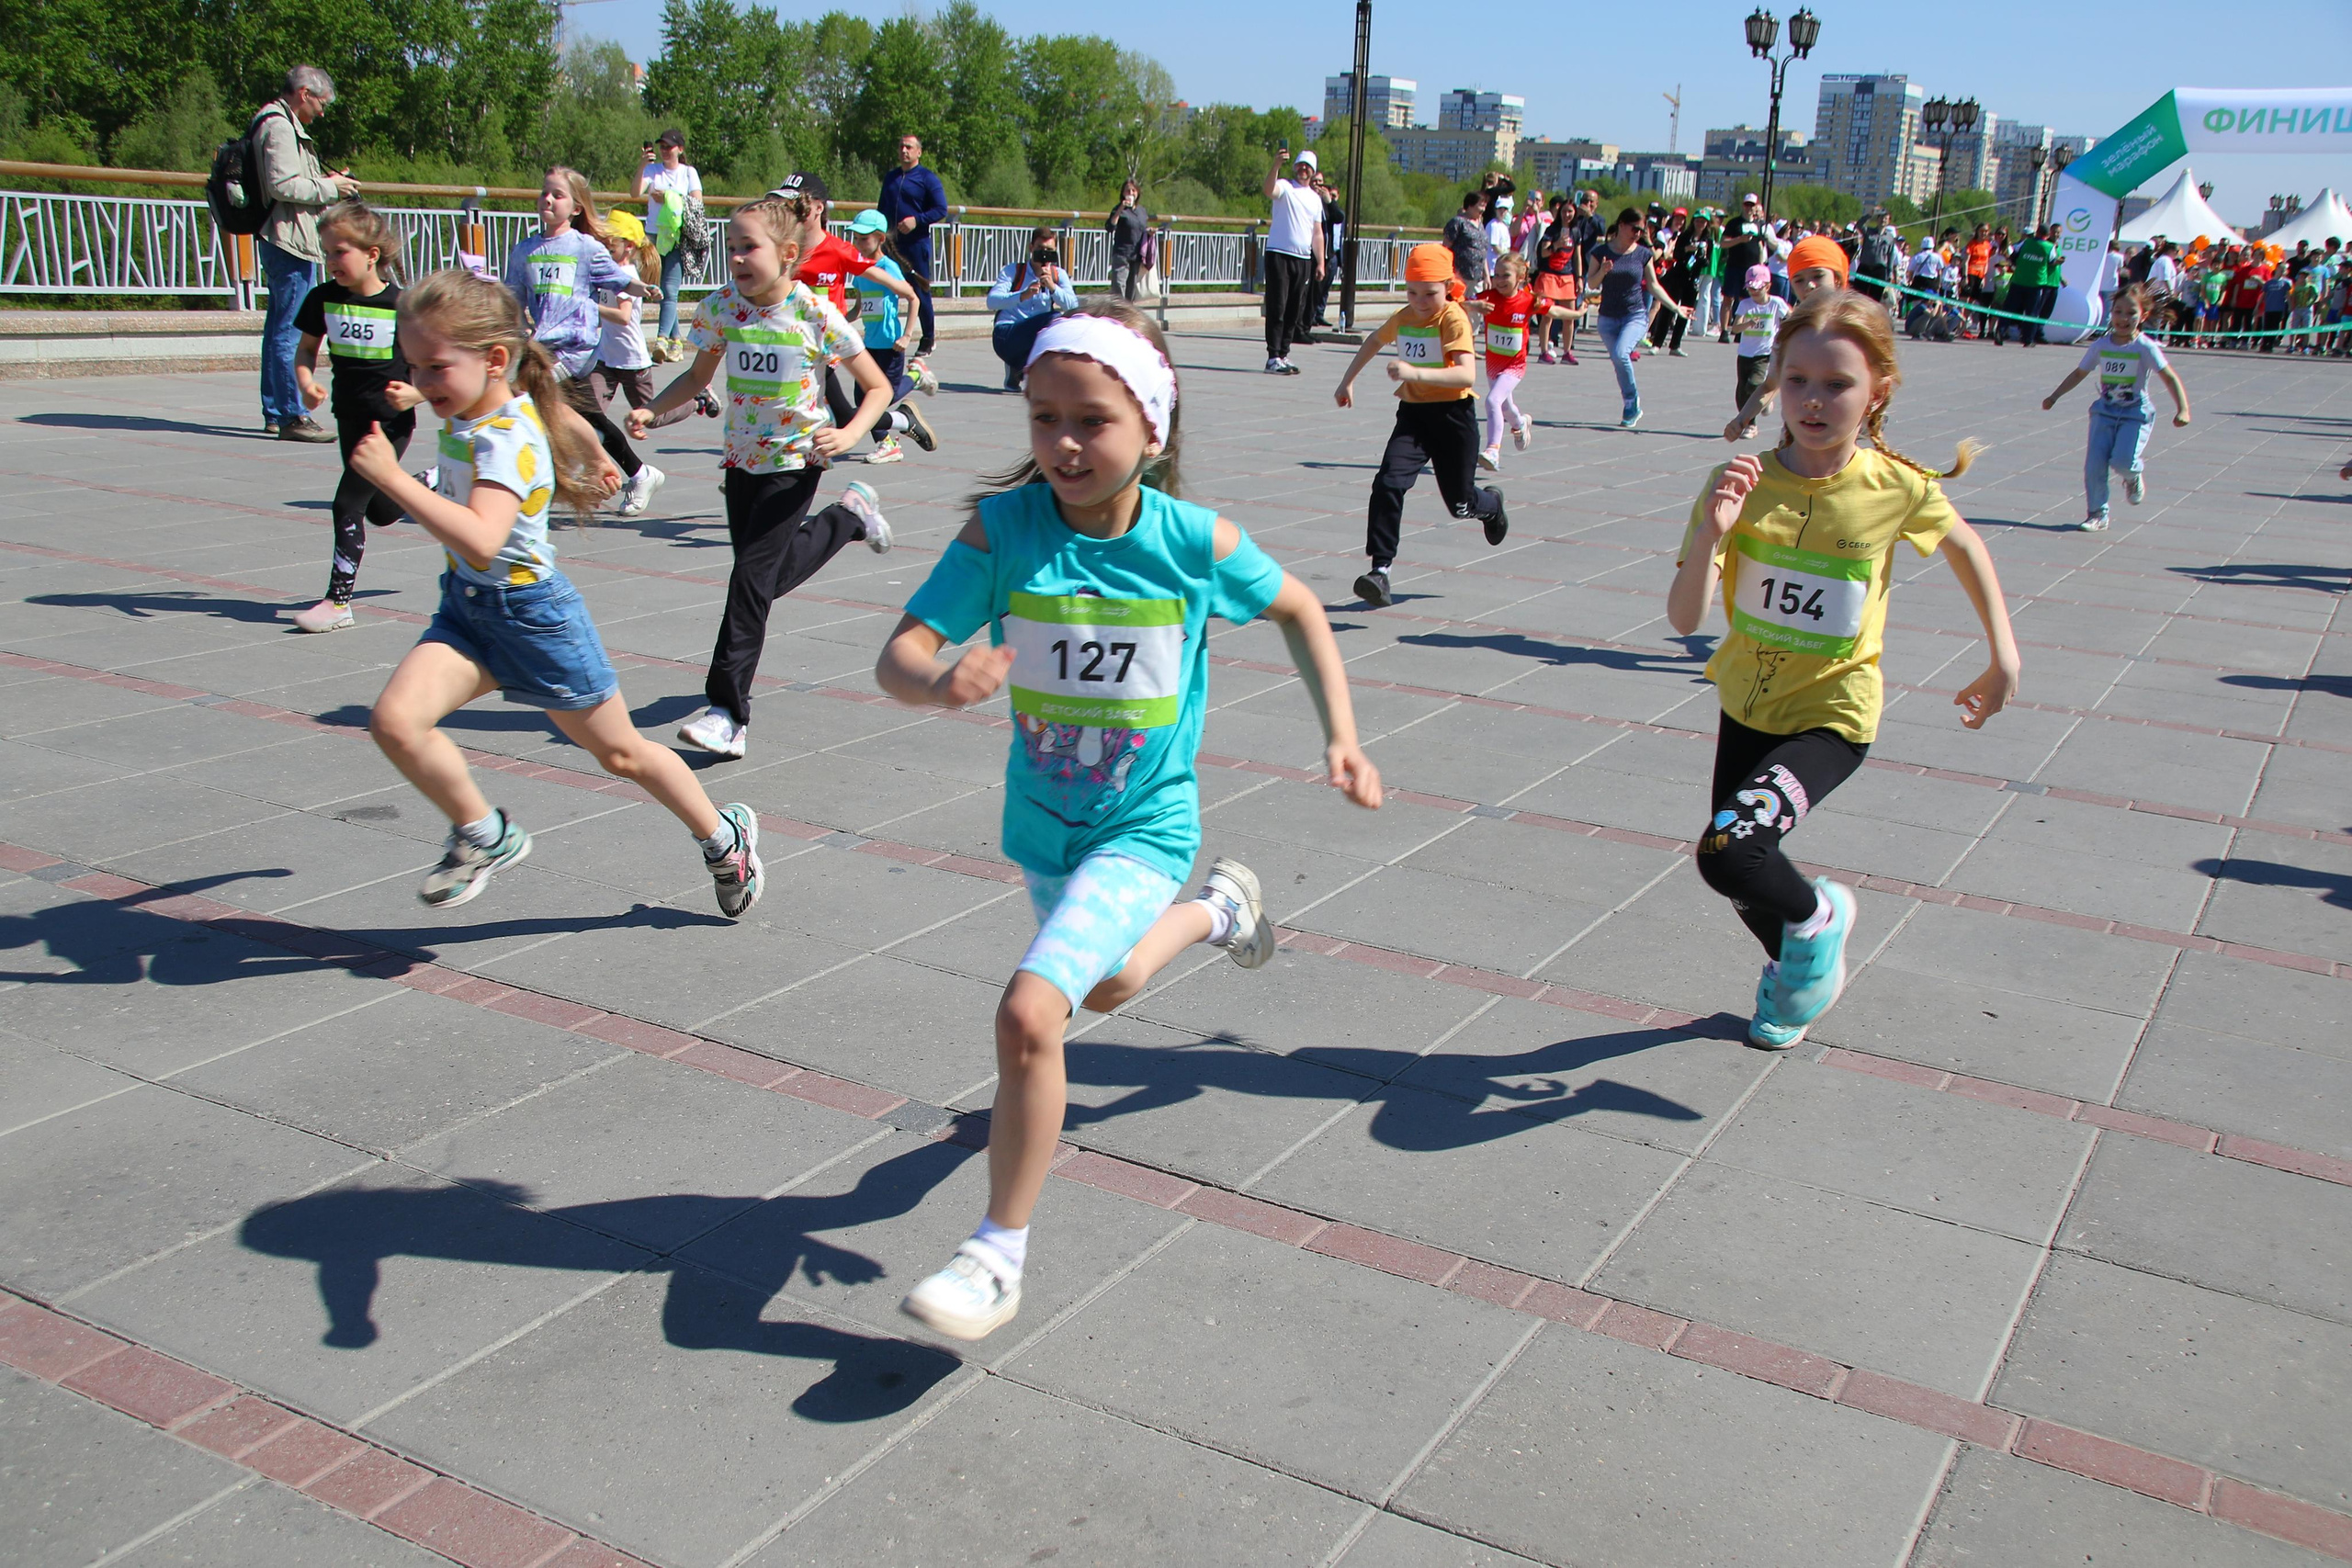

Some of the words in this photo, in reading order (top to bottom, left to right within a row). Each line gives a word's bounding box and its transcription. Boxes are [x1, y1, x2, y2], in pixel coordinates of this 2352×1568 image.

[2100, 123, 2157, 169] зелёный
[2107, 133, 2165, 178] марафон
[2063, 236, 2099, 253] БЕР
[538, 266, 560, 280] 141
[340, 321, 375, 341] 285
[1495, 334, 1514, 347] 117
[1405, 342, 1426, 358] 213
[739, 350, 778, 374] 020
[2105, 361, 2127, 374] 089
[1848, 541, 1871, 549] СБЕР
[1760, 578, 1826, 621] 154
[1746, 623, 1792, 644] ДЕТСКИЙ
[1793, 637, 1826, 649] ЗАБЕГ
[1050, 639, 1138, 683] 127
[1040, 703, 1103, 719] ДЕТСКИЙ
[1104, 708, 1148, 721] ЗАБЕГ
